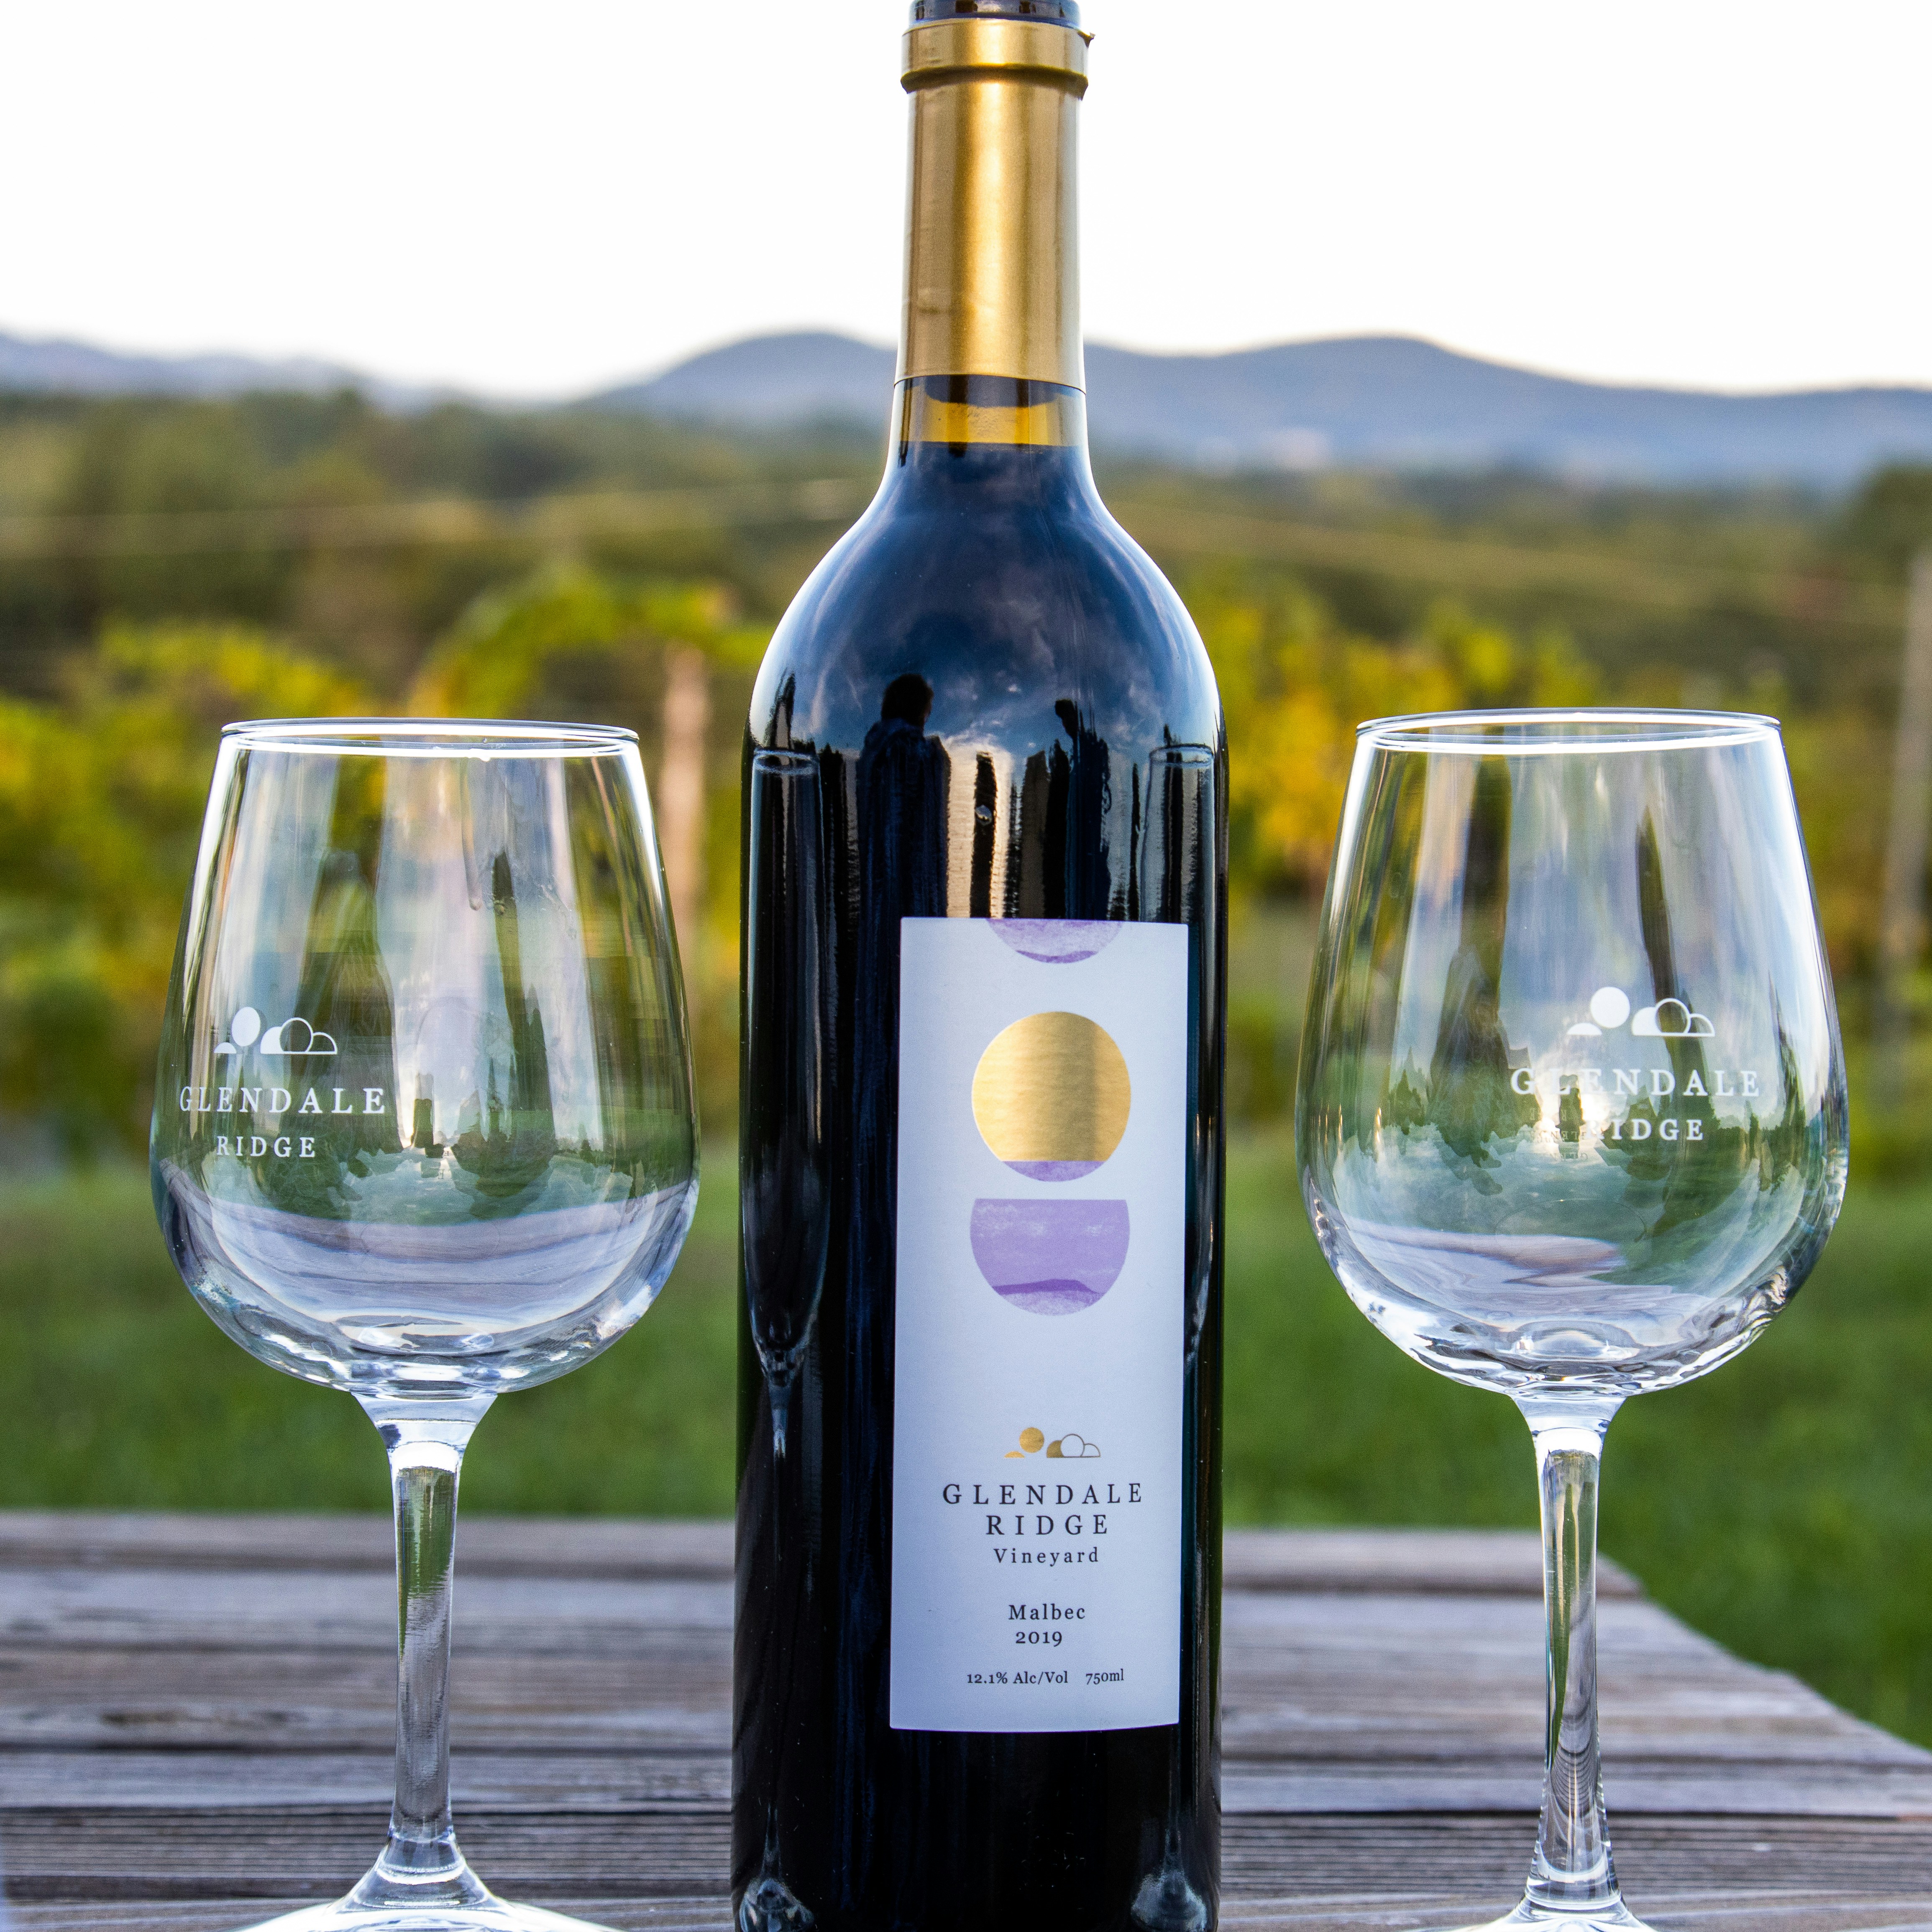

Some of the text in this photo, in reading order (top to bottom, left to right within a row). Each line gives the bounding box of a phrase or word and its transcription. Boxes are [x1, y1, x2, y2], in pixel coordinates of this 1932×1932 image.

[1510, 1067, 1760, 1097] GLENDALE
[180, 1086, 384, 1114] GLENDALE
[216, 1136, 315, 1157] RIDGE
[942, 1483, 1141, 1505] GLENDALE
[986, 1515, 1108, 1535] RIDGE
[993, 1547, 1099, 1567] Vineyard
[1008, 1603, 1085, 1620] Malbec
[1016, 1631, 1062, 1647] 2019
[967, 1668, 1124, 1685] 12.1% Alc/Vol 750ml
